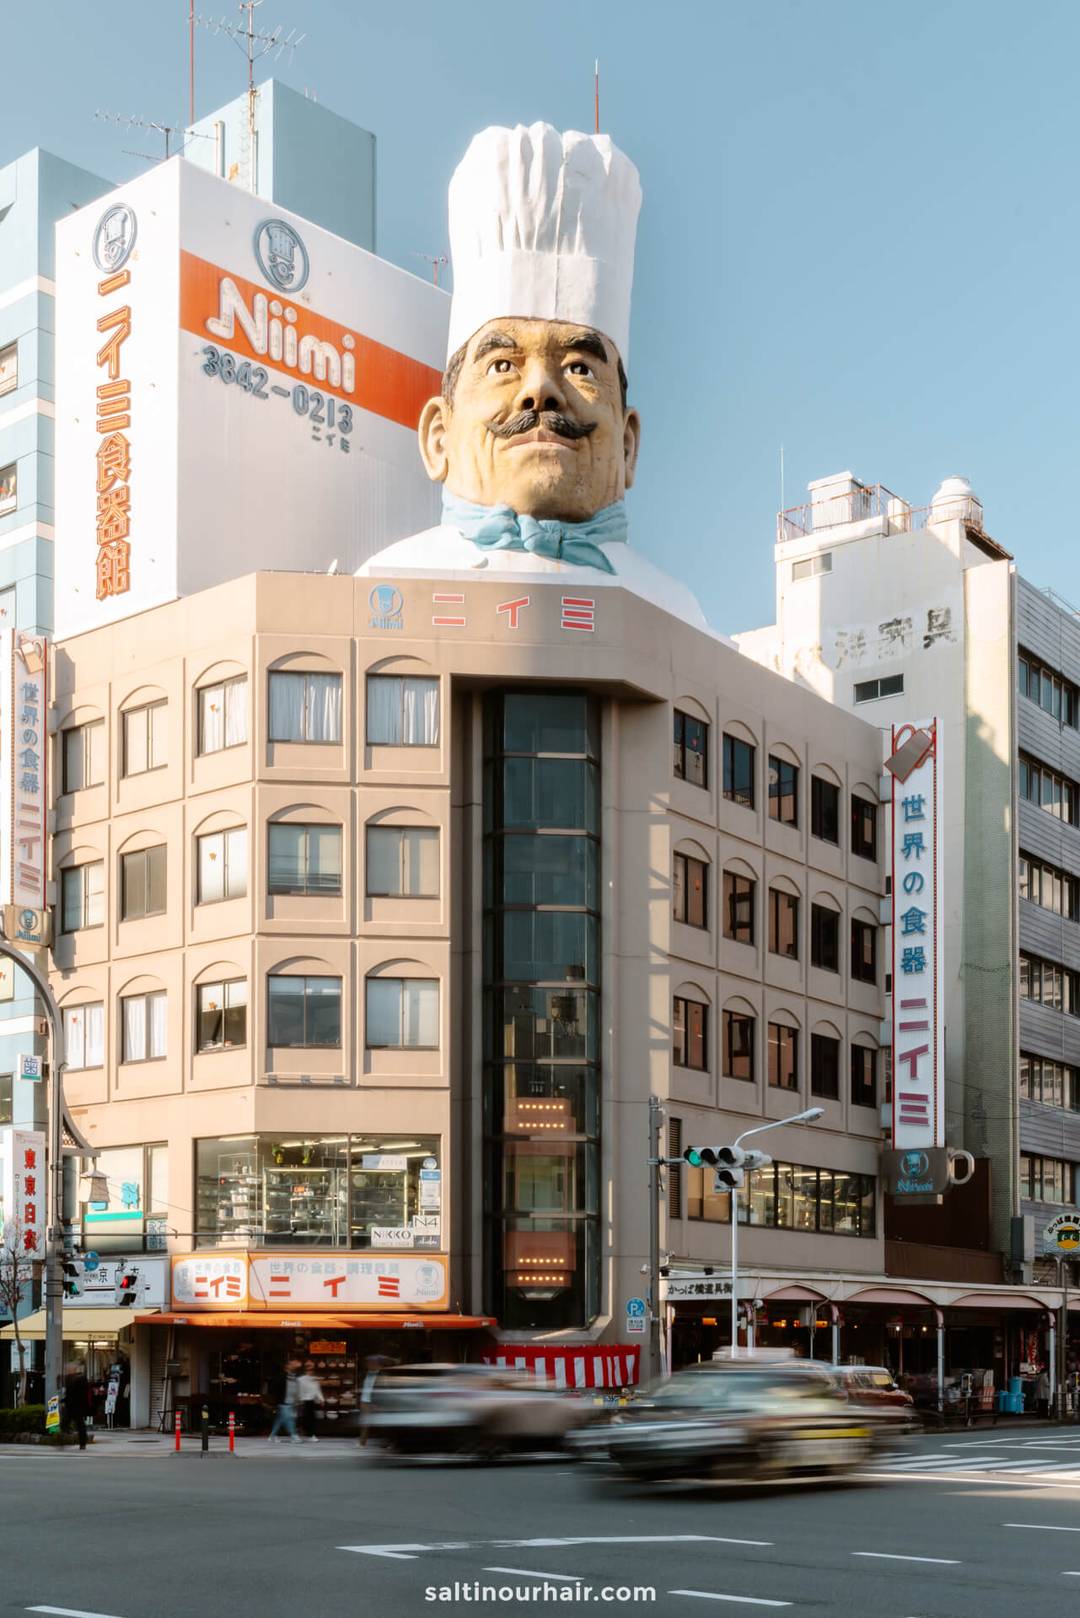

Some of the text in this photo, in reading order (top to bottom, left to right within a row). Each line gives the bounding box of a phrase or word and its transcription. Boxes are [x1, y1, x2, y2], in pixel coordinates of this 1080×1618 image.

[204, 276, 356, 394] Niimi
[201, 345, 354, 434] 3842-0213
[96, 269, 131, 600] ニイミ食器館
[368, 617, 404, 630] Niimi
[432, 593, 594, 632] ニイミ
[900, 794, 927, 974] 世界の食器
[374, 1231, 411, 1239] NIKKO
[194, 1275, 241, 1298] ニイミ
[268, 1275, 401, 1298] ニイミ
